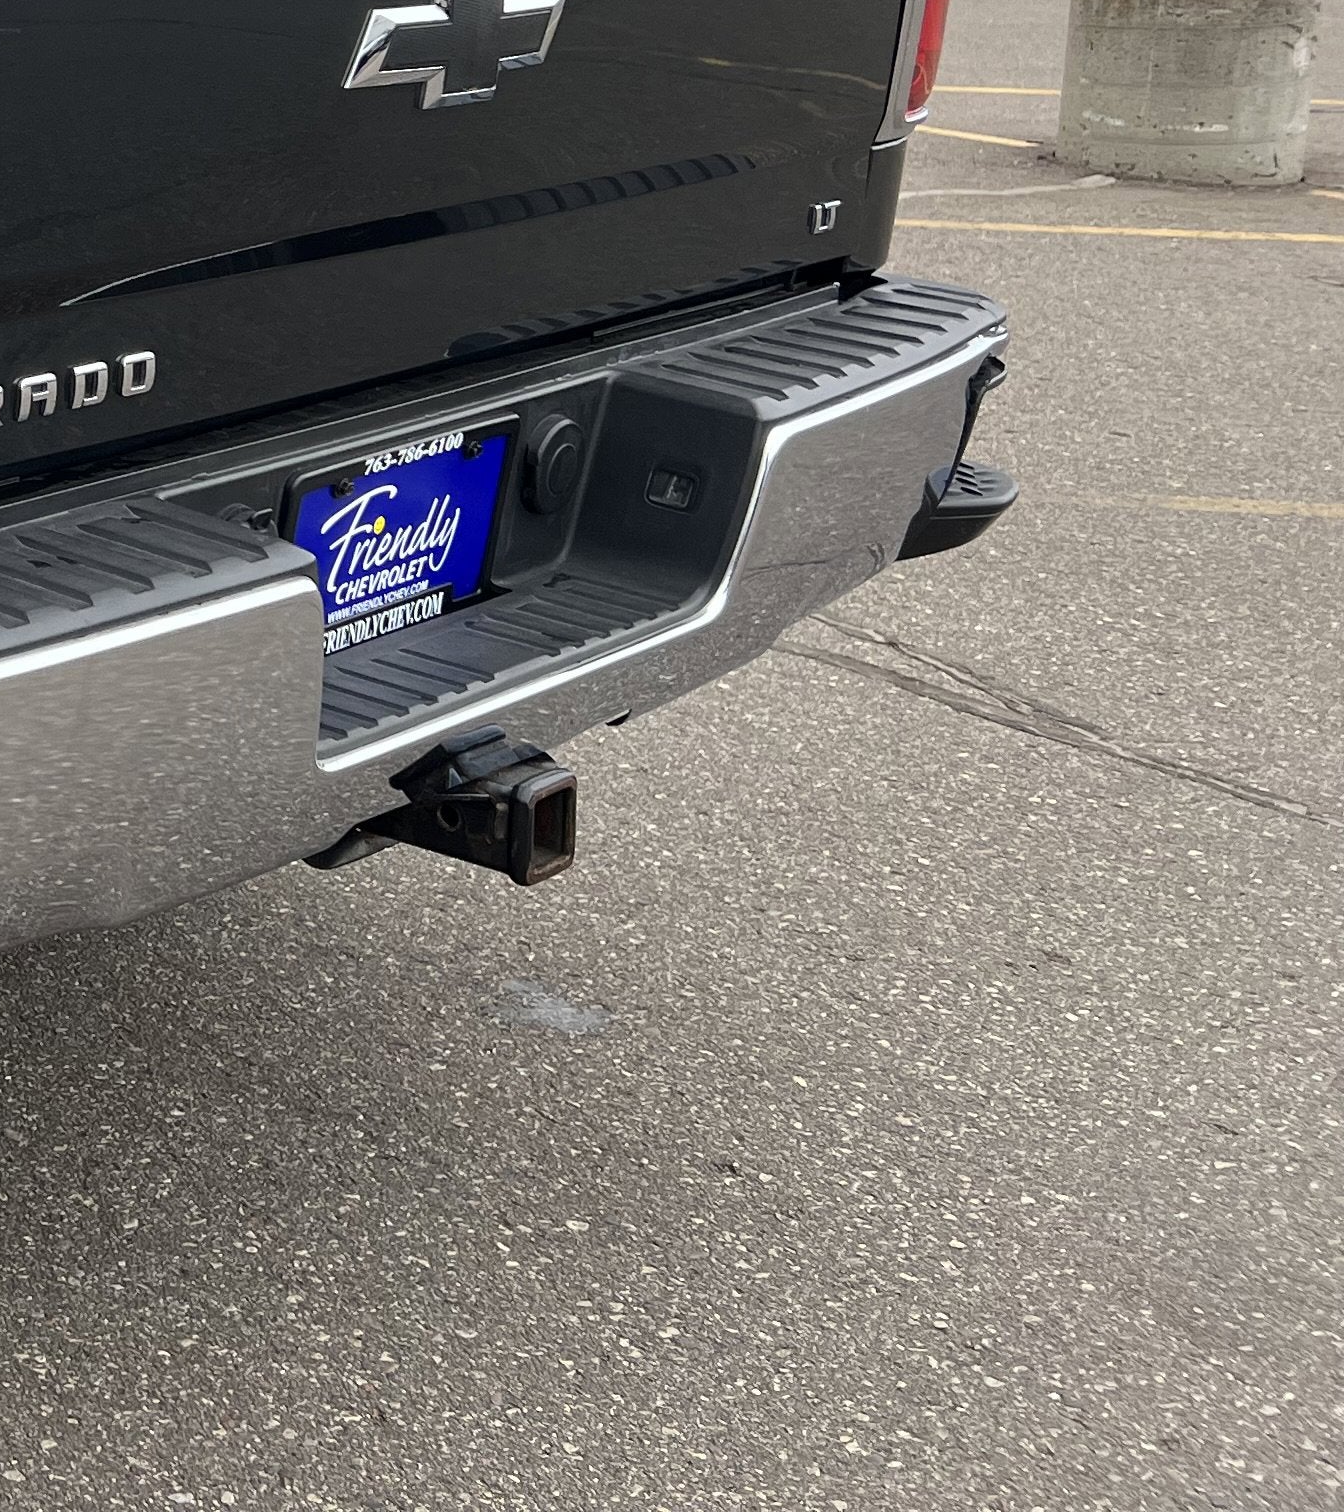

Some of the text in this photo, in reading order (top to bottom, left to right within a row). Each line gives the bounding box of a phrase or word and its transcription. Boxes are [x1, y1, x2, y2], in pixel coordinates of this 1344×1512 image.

[812, 200, 842, 235] LT
[364, 433, 464, 476] 763-786-6100
[321, 484, 461, 593] Friendly
[335, 556, 428, 605] CHEVROLET
